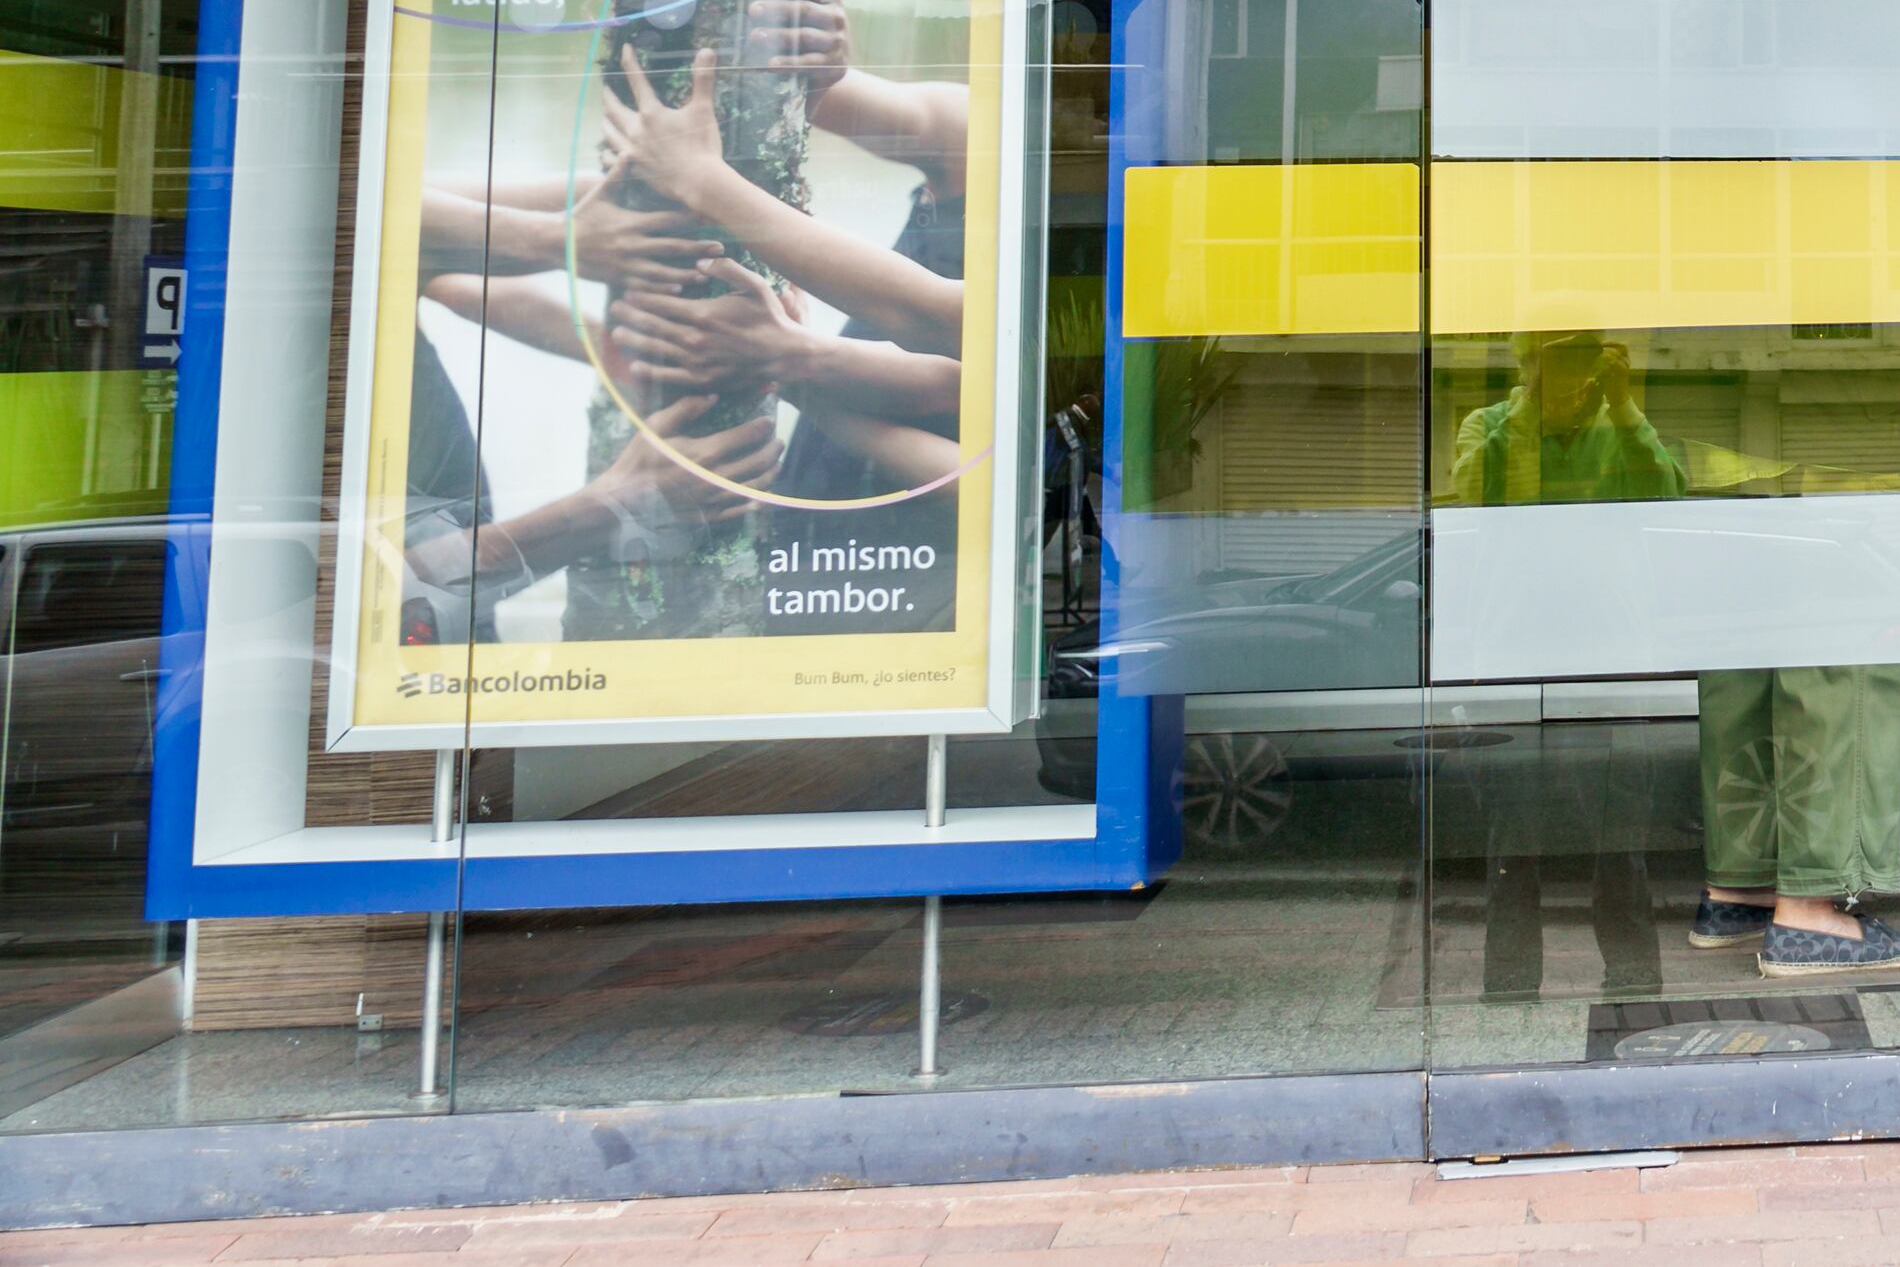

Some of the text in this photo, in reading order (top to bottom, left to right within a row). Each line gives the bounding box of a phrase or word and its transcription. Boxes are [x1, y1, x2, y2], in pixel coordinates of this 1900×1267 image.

[768, 539, 936, 573] al mismo
[768, 582, 914, 615] tambor.
[428, 668, 608, 696] Bancolombia
[794, 667, 957, 687] Bum Bum, ¿lo sientes?
